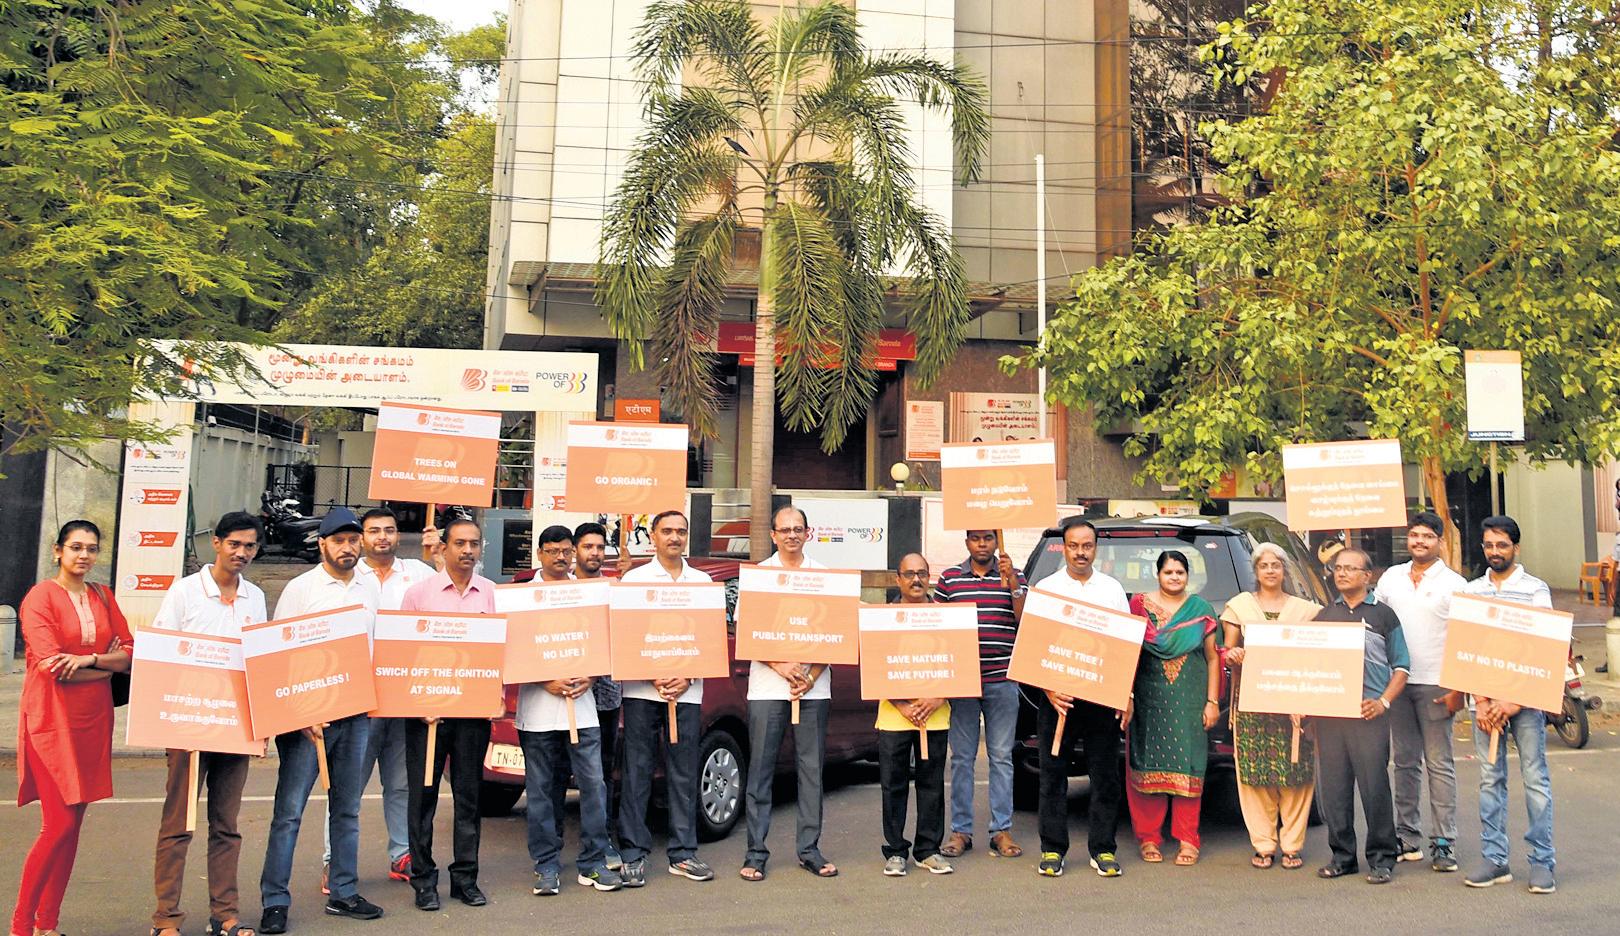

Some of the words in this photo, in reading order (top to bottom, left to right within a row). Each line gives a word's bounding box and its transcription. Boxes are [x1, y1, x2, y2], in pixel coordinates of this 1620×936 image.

[373, 353, 414, 367] சங்கமம்
[536, 372, 569, 380] POWER
[553, 380, 566, 389] OF
[625, 403, 652, 415] एटीएम
[414, 457, 443, 468] TREES
[444, 460, 457, 469] ON
[381, 470, 416, 481] GLOBAL
[417, 472, 460, 484] WARMING
[461, 476, 485, 486] GONE
[595, 475, 608, 485] GO
[611, 476, 652, 487] ORGANIC
[789, 616, 808, 626] USE
[534, 634, 549, 644] NO
[551, 631, 584, 642] WATER
[752, 630, 786, 641] PUBLIC
[788, 632, 843, 644] TRANSPORT
[543, 650, 557, 660] NO
[559, 648, 580, 659] LIFE
[886, 654, 910, 664] SAVE
[912, 653, 948, 664] NATURE
[1048, 644, 1073, 658] SAVE
[1074, 651, 1097, 666] TREE
[1041, 658, 1065, 673] SAVE
[1066, 665, 1098, 682] WATER
[1456, 650, 1475, 663] SAY
[1476, 654, 1491, 666] NO
[1492, 658, 1505, 669] TO
[1506, 661, 1546, 679] PLASTIC
[375, 666, 408, 677] SWICH
[410, 667, 430, 677] OFF
[431, 668, 453, 678] THE
[454, 668, 500, 679] IGNITION
[887, 670, 911, 680] SAVE
[912, 669, 949, 680] FUTURE
[275, 687, 290, 698] GO
[291, 673, 345, 695] PAPERLESS
[410, 685, 424, 695] AT
[425, 685, 463, 695] SIGNAL
